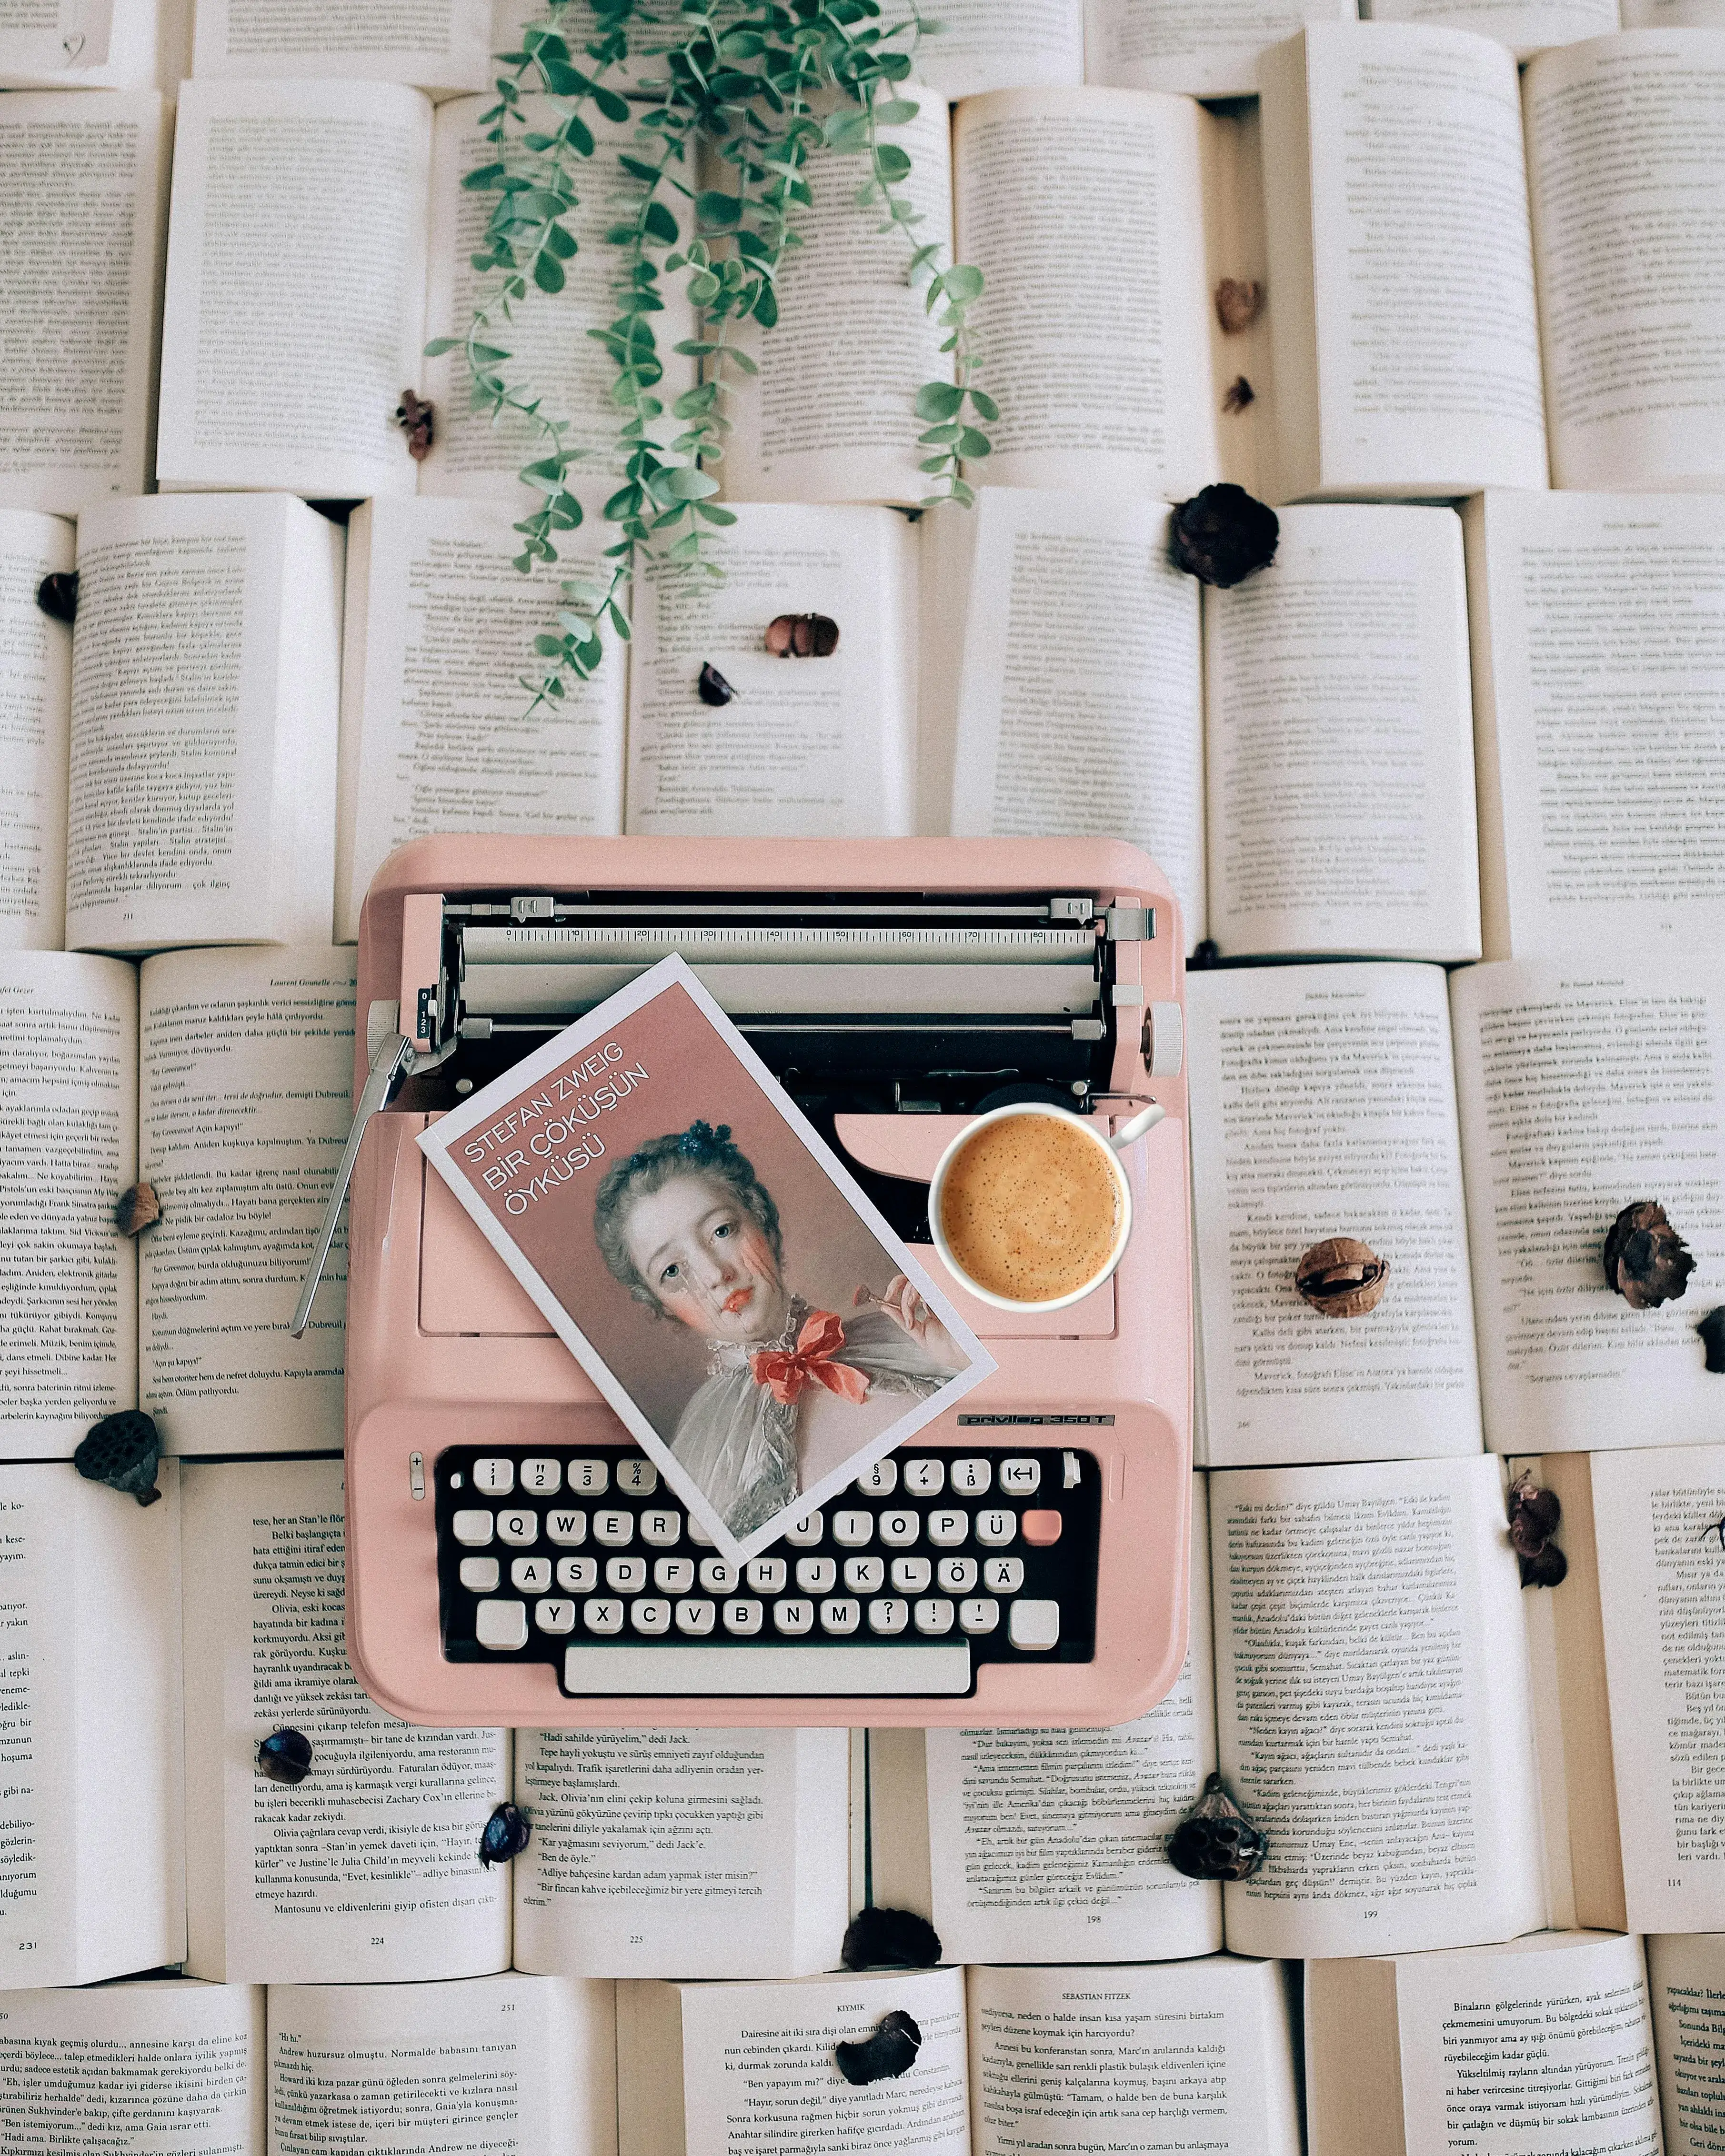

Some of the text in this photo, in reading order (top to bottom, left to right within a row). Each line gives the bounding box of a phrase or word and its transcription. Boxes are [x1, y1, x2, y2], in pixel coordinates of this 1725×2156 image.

[464, 1041, 624, 1163] STEFAN ZWEIG
[481, 1062, 650, 1191] BİR ÇÖKÜŞÜN
[503, 1132, 605, 1215] ÖYKÜSÜ
[1050, 1415, 1091, 1424] 350
[1095, 1415, 1107, 1424] T
[491, 1474, 495, 1485] 1
[535, 1474, 544, 1486] 2
[582, 1475, 592, 1486] 3
[632, 1475, 641, 1486] 4
[872, 1474, 881, 1485] 9
[509, 1517, 523, 1535] Q
[557, 1517, 575, 1532] W
[606, 1518, 619, 1533] E
[653, 1517, 666, 1533] R
[851, 1519, 854, 1534] I
[892, 1518, 906, 1534] O
[942, 1518, 954, 1533] P
[990, 1515, 1003, 1534] Ü
[252, 1546, 270, 1555] hata
[524, 1562, 1010, 1583] A S D F G H J K L Ö Ä
[549, 1606, 847, 1623] Y X C V B N M
[6, 1617, 28, 1629] yakın
[253, 1619, 293, 1631] hayatında
[253, 1633, 311, 1645] korkmuyordu.
[10, 1667, 30, 1679] tepki
[253, 1663, 291, 1675] hayranlık
[317, 1720, 380, 1733] çıkarıp telefon
[564, 1733, 690, 1744] sahilde dedi Jack.
[1, 1753, 33, 1763] hoşuma
[359, 1748, 480, 1762] ilgileniyordu, restoranın
[399, 1763, 440, 1773] Faturaları
[577, 1764, 650, 1775] Trafik işaretlerini
[355, 1780, 393, 1791] karmaşık
[562, 1778, 620, 1789] başlamışlardı.
[328, 1795, 421, 1805] muhasebecisi Zachary
[0, 1836, 36, 1850] gözlerin-
[0, 1852, 36, 1865] söyledik-
[612, 1870, 641, 1879] kardan
[274, 1901, 417, 1914] Mantosunu eldivenlerini giyip
[1364, 1911, 1378, 1919] 199
[19, 1942, 37, 1950] 231
[371, 1937, 384, 1945] 224
[837, 2004, 865, 2012] KIYMIK
[1454, 1998, 1542, 2012] Binaların gölgelerinde
[1017, 2012, 1042, 2021] neden
[1053, 2012, 1076, 2022] halde
[1104, 2014, 1122, 2022] kısa
[1124, 2015, 1151, 2024] yaşam
[1442, 2018, 1543, 2031] çekmemesini umuyorum.
[1033, 2027, 1135, 2039] koymak için harcıyordu?
[34, 2037, 195, 2049] kıyak geçmiş olurdu... annesine karşı
[1459, 2037, 1498, 2047] yanmıyor
[307, 2046, 478, 2060] huzursuz olmuştu. Normalde babasını
[743, 2045, 781, 2054] cebinden
[1034, 2045, 1087, 2055] konferanstan
[64, 2052, 135, 2063] talep etmedikleri
[1444, 2048, 1550, 2064] rüyebileceğim kadar güçlü.
[24, 2065, 158, 2076] sadece estetik bakmamak
[738, 2059, 808, 2070] durmak zorunda
[1456, 2066, 1538, 2079] Yükseltilmiş rayların
[44, 2079, 96, 2090] umduğumuz
[336, 2071, 498, 2088] pazar günü öğleden gelmelerini
[414, 2111, 519, 2127] müşteri gençler
[726, 2110, 859, 2123] Sonra korkusuna hiçbir
[728, 2127, 835, 2139] Anahtar girerken
